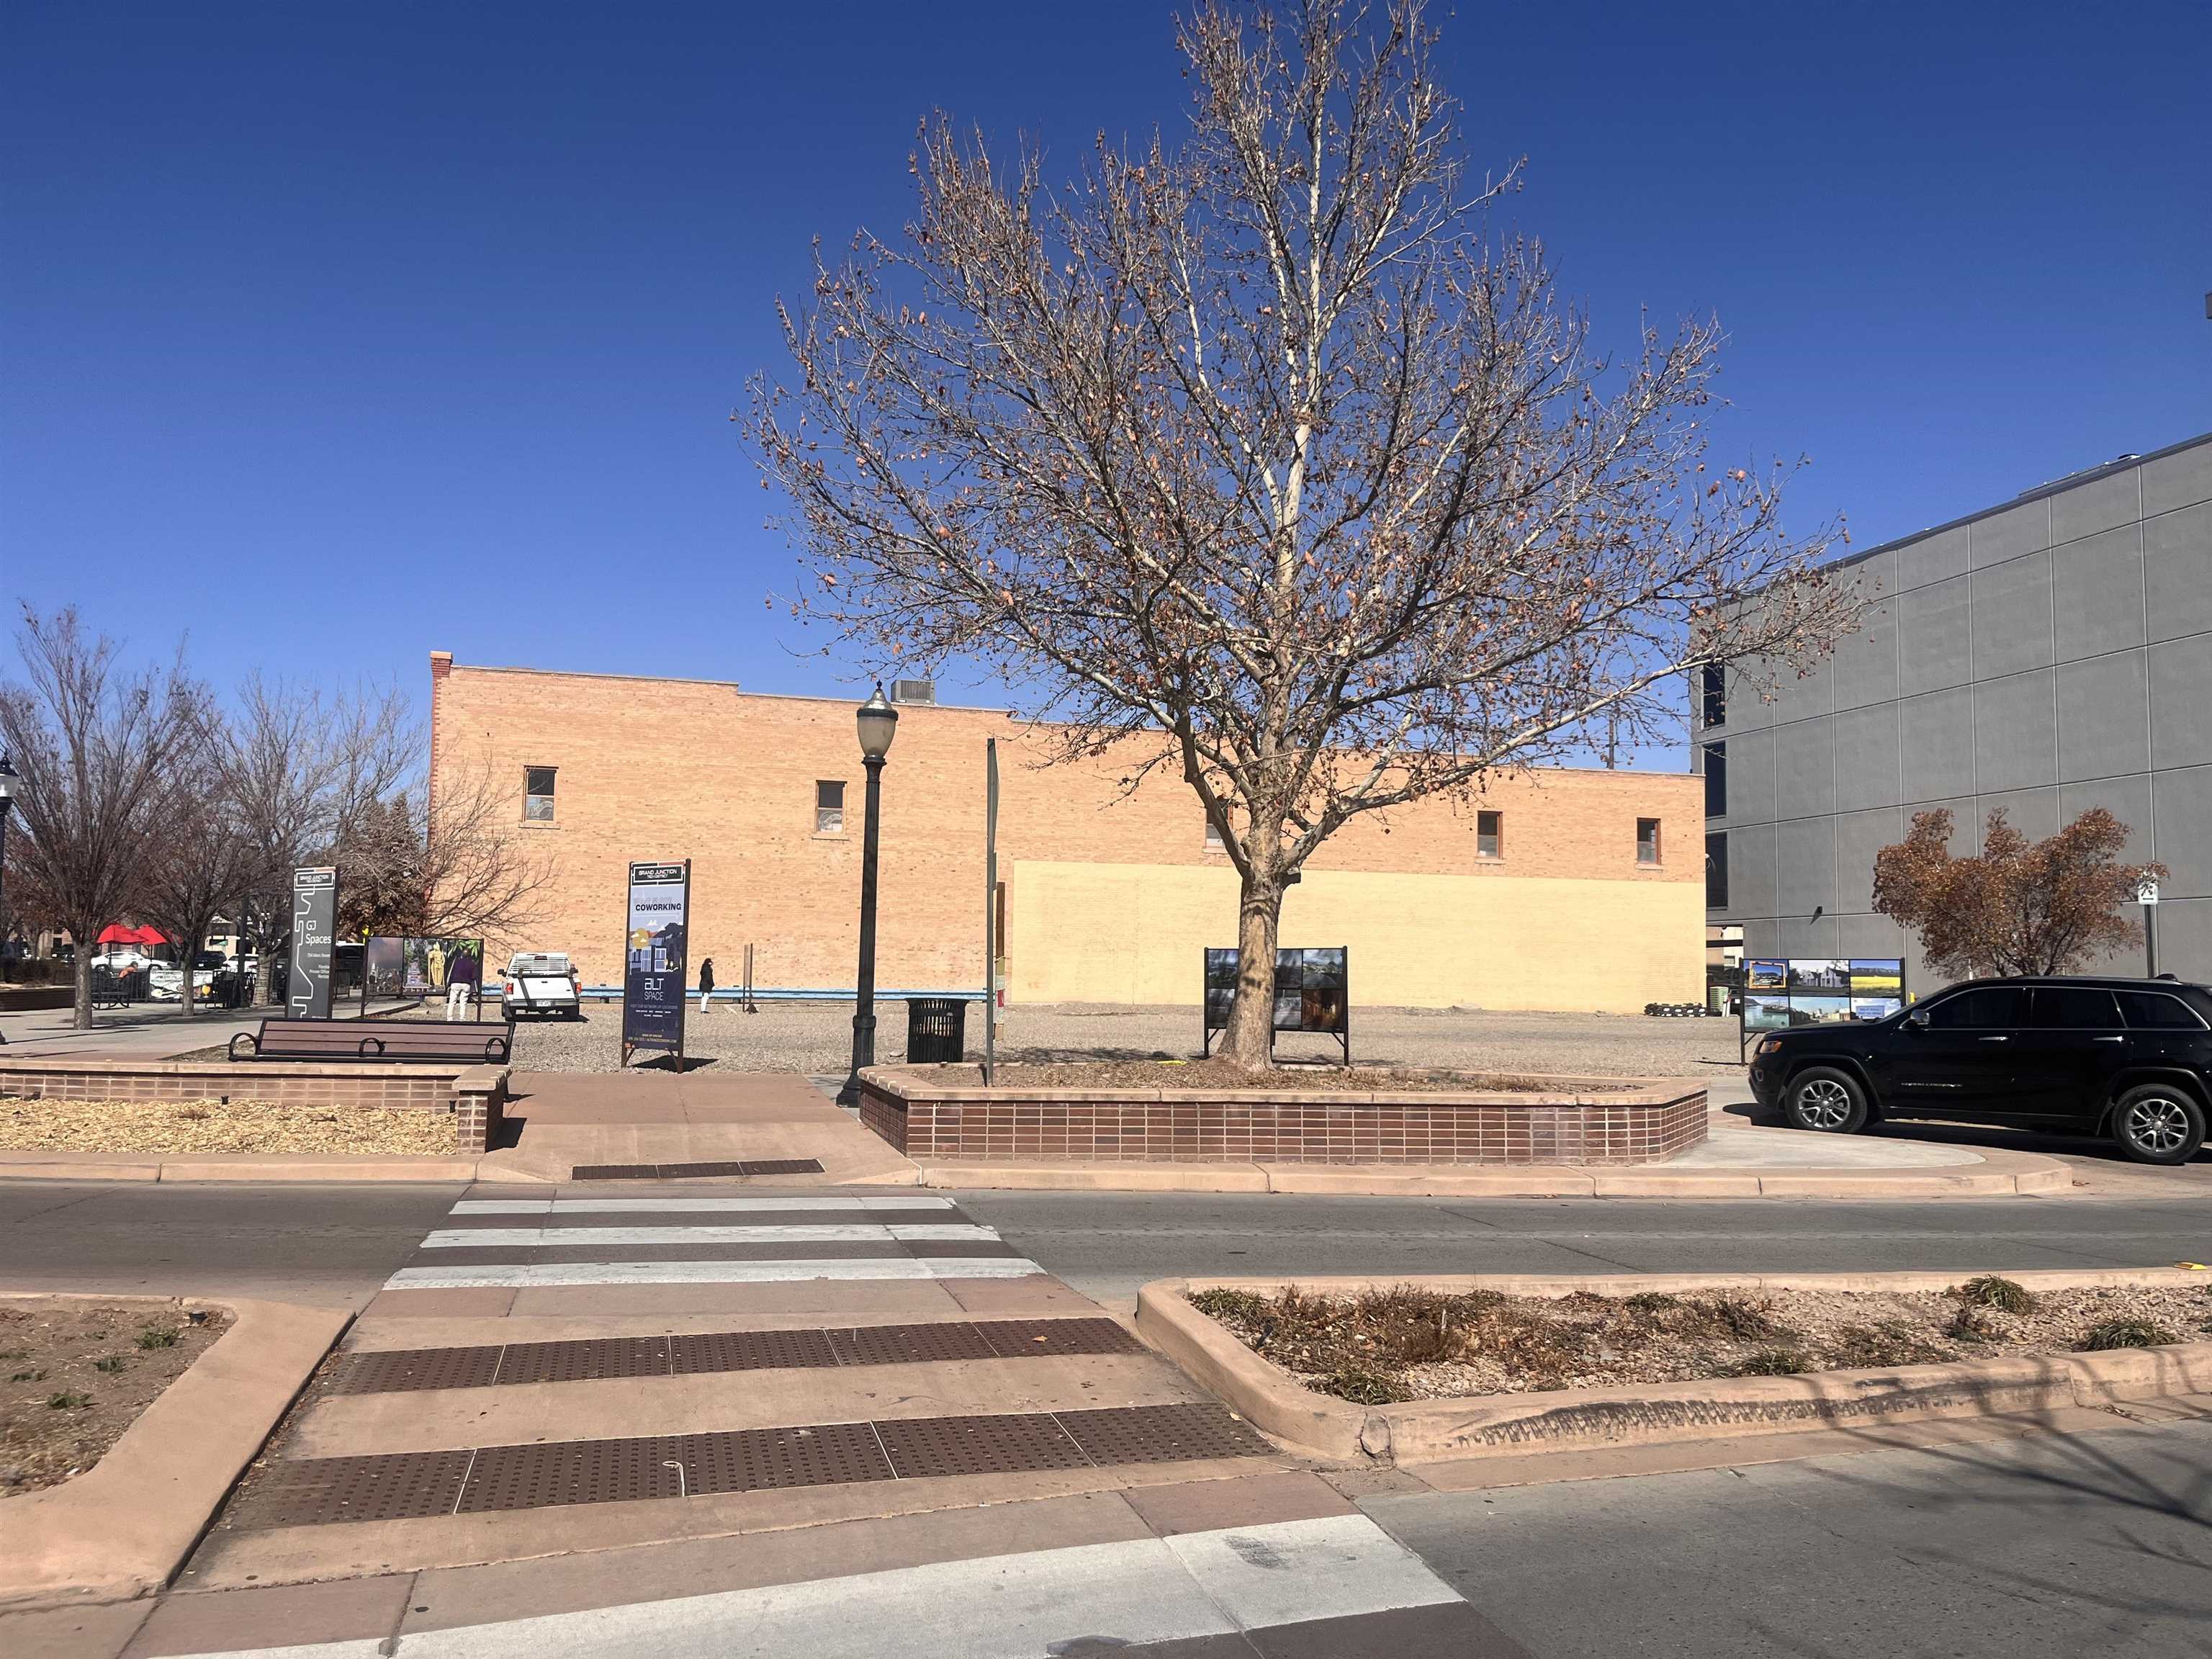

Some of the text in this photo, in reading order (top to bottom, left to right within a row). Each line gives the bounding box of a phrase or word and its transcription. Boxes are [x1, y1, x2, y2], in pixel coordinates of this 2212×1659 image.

[306, 920, 317, 931] GJ
[305, 933, 332, 946] Spaces
[644, 991, 664, 1001] SPACE
